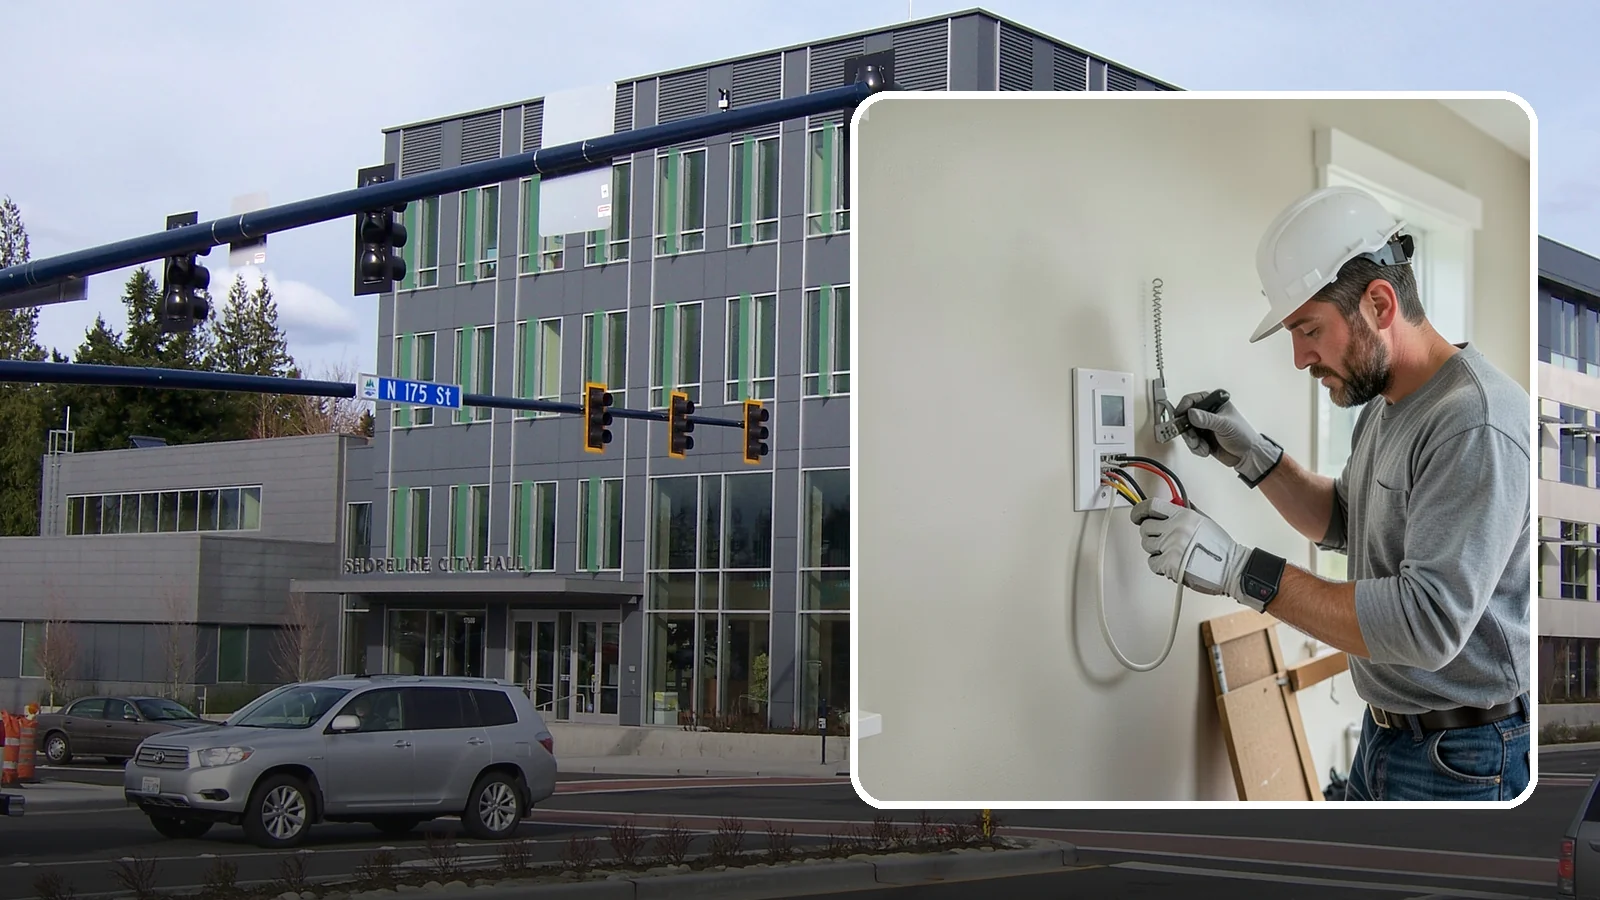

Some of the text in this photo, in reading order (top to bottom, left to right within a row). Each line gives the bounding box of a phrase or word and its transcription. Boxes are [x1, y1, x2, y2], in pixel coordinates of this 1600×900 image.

[387, 381, 451, 406] N 175 St
[344, 556, 525, 574] SHORELINE CITY HALL
